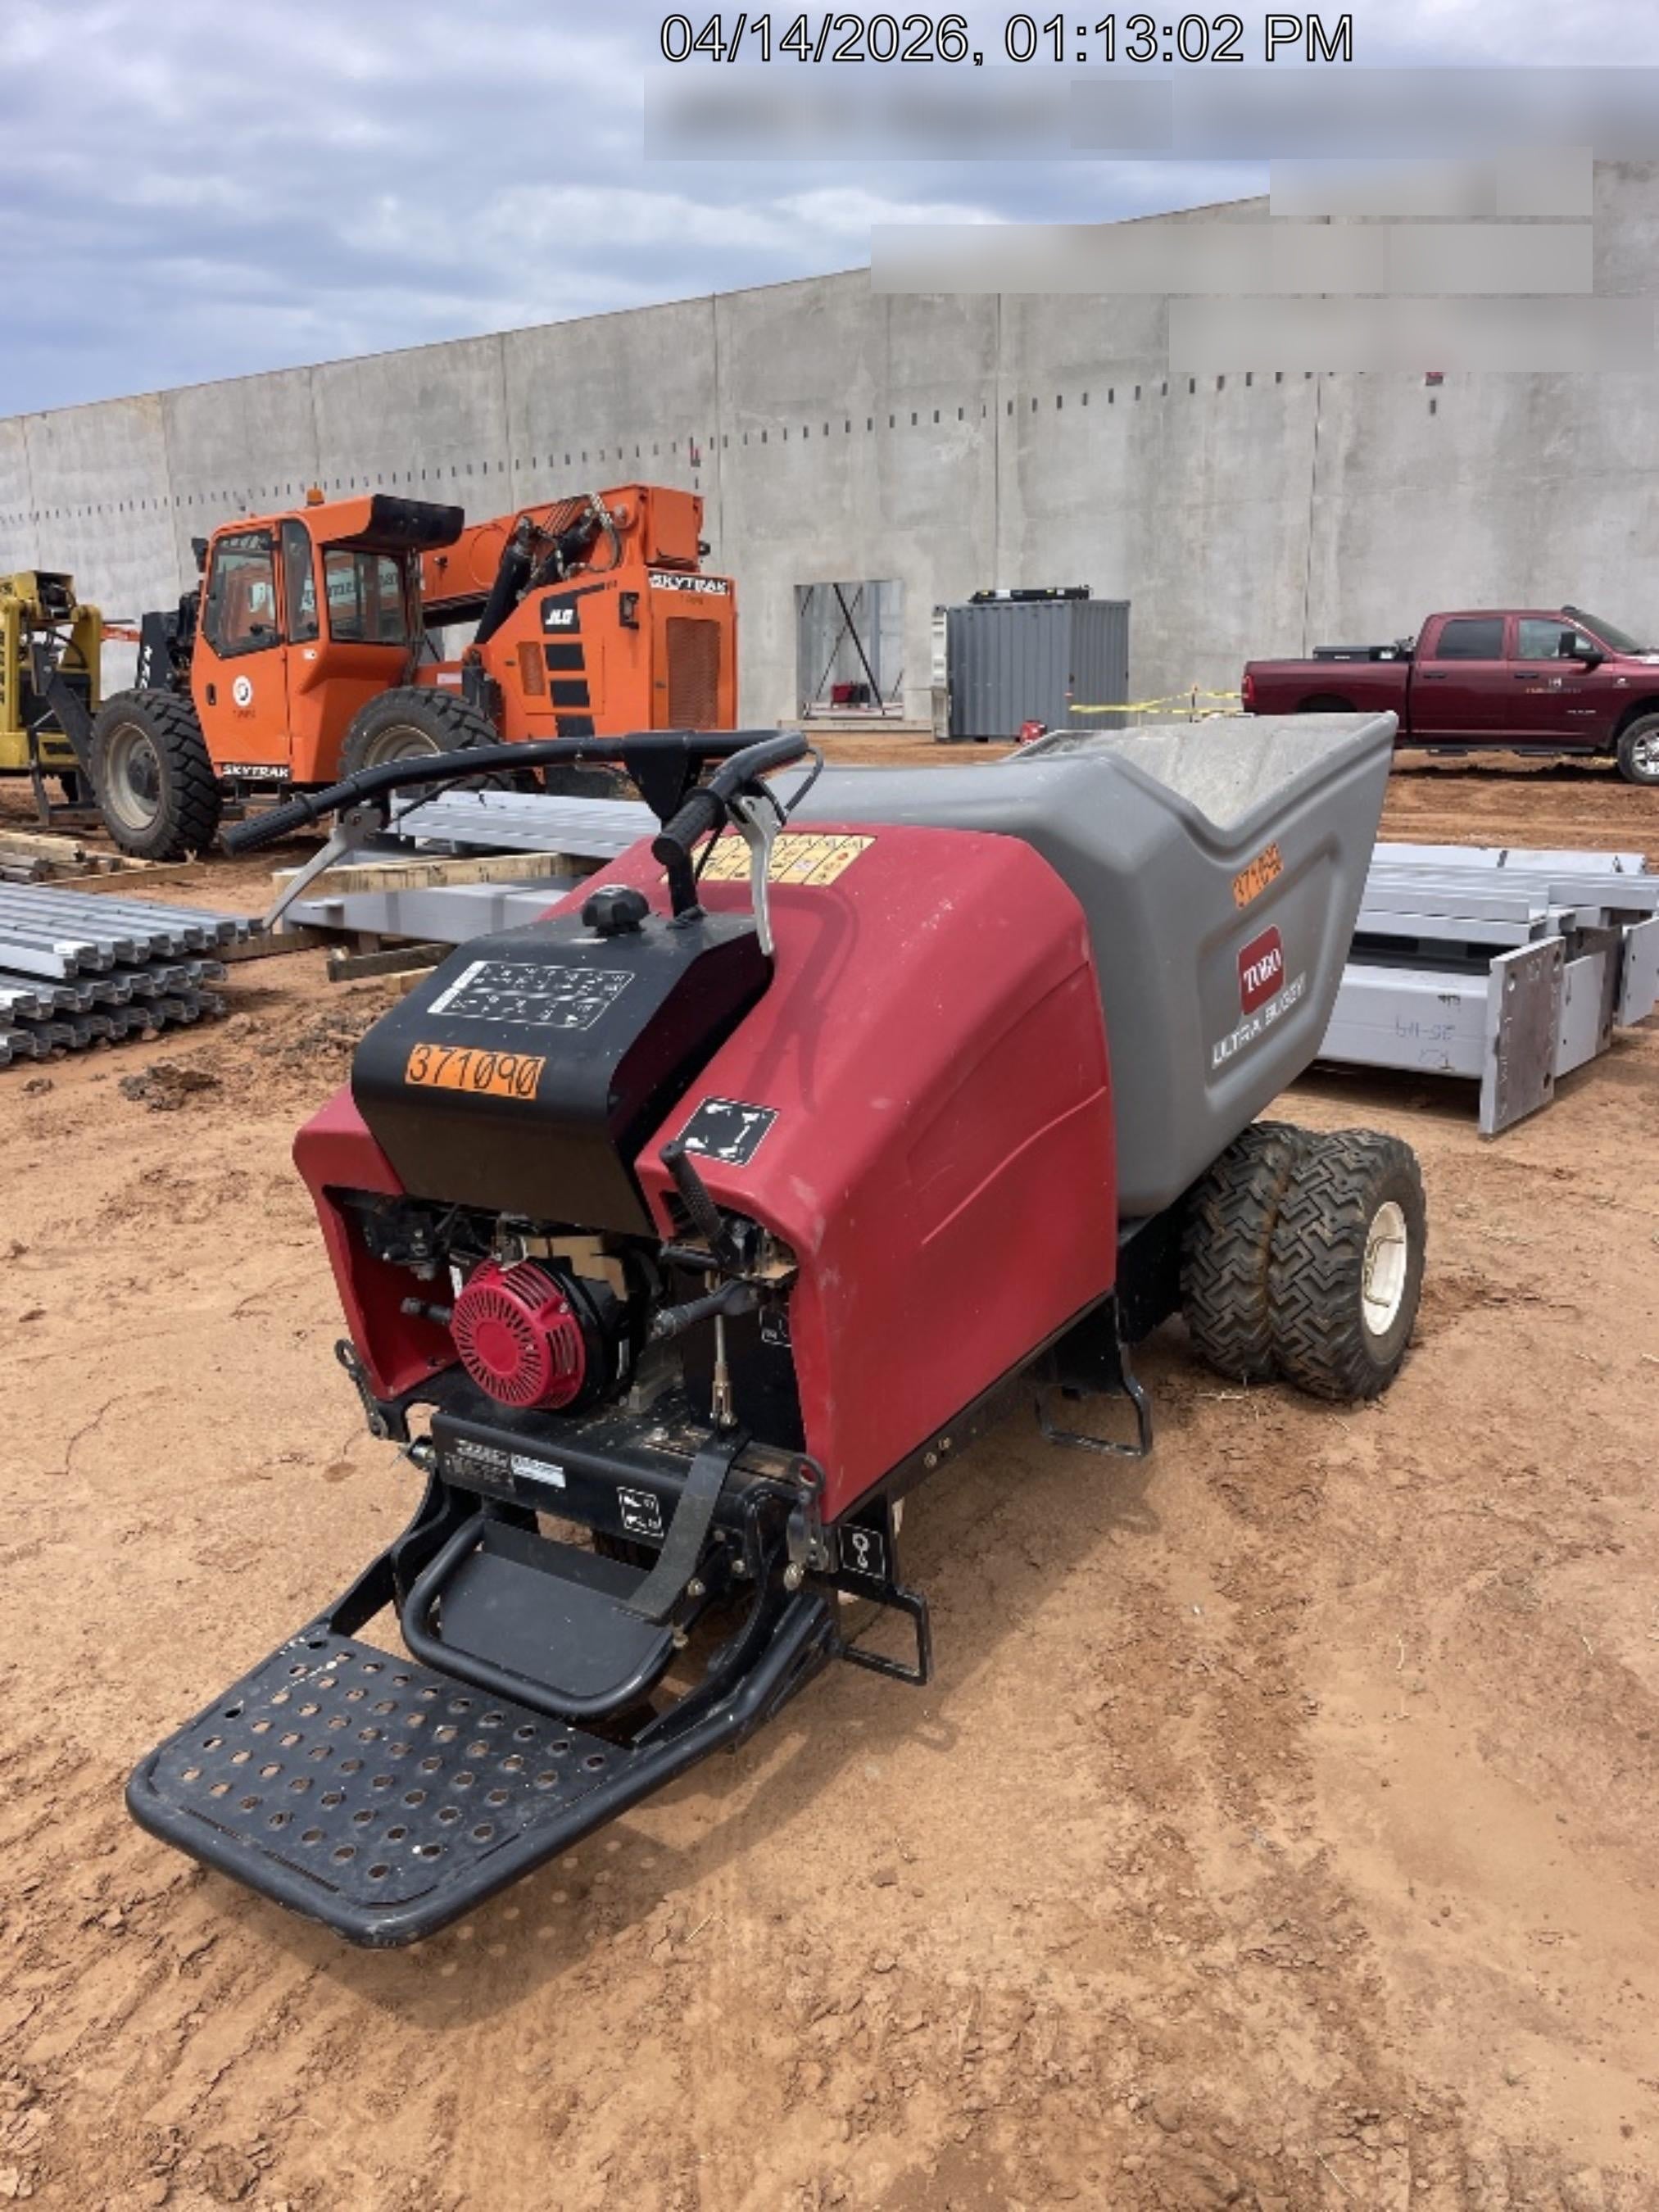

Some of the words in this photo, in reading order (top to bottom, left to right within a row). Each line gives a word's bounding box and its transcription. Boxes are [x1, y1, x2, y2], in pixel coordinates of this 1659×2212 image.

[650, 573, 728, 595] SKYTRAK
[545, 608, 574, 625] JLG
[222, 764, 289, 778] SKYTRAK
[1243, 948, 1283, 994] TORO
[1212, 1018, 1262, 1068] ULTRA
[410, 1045, 542, 1096] 371090
